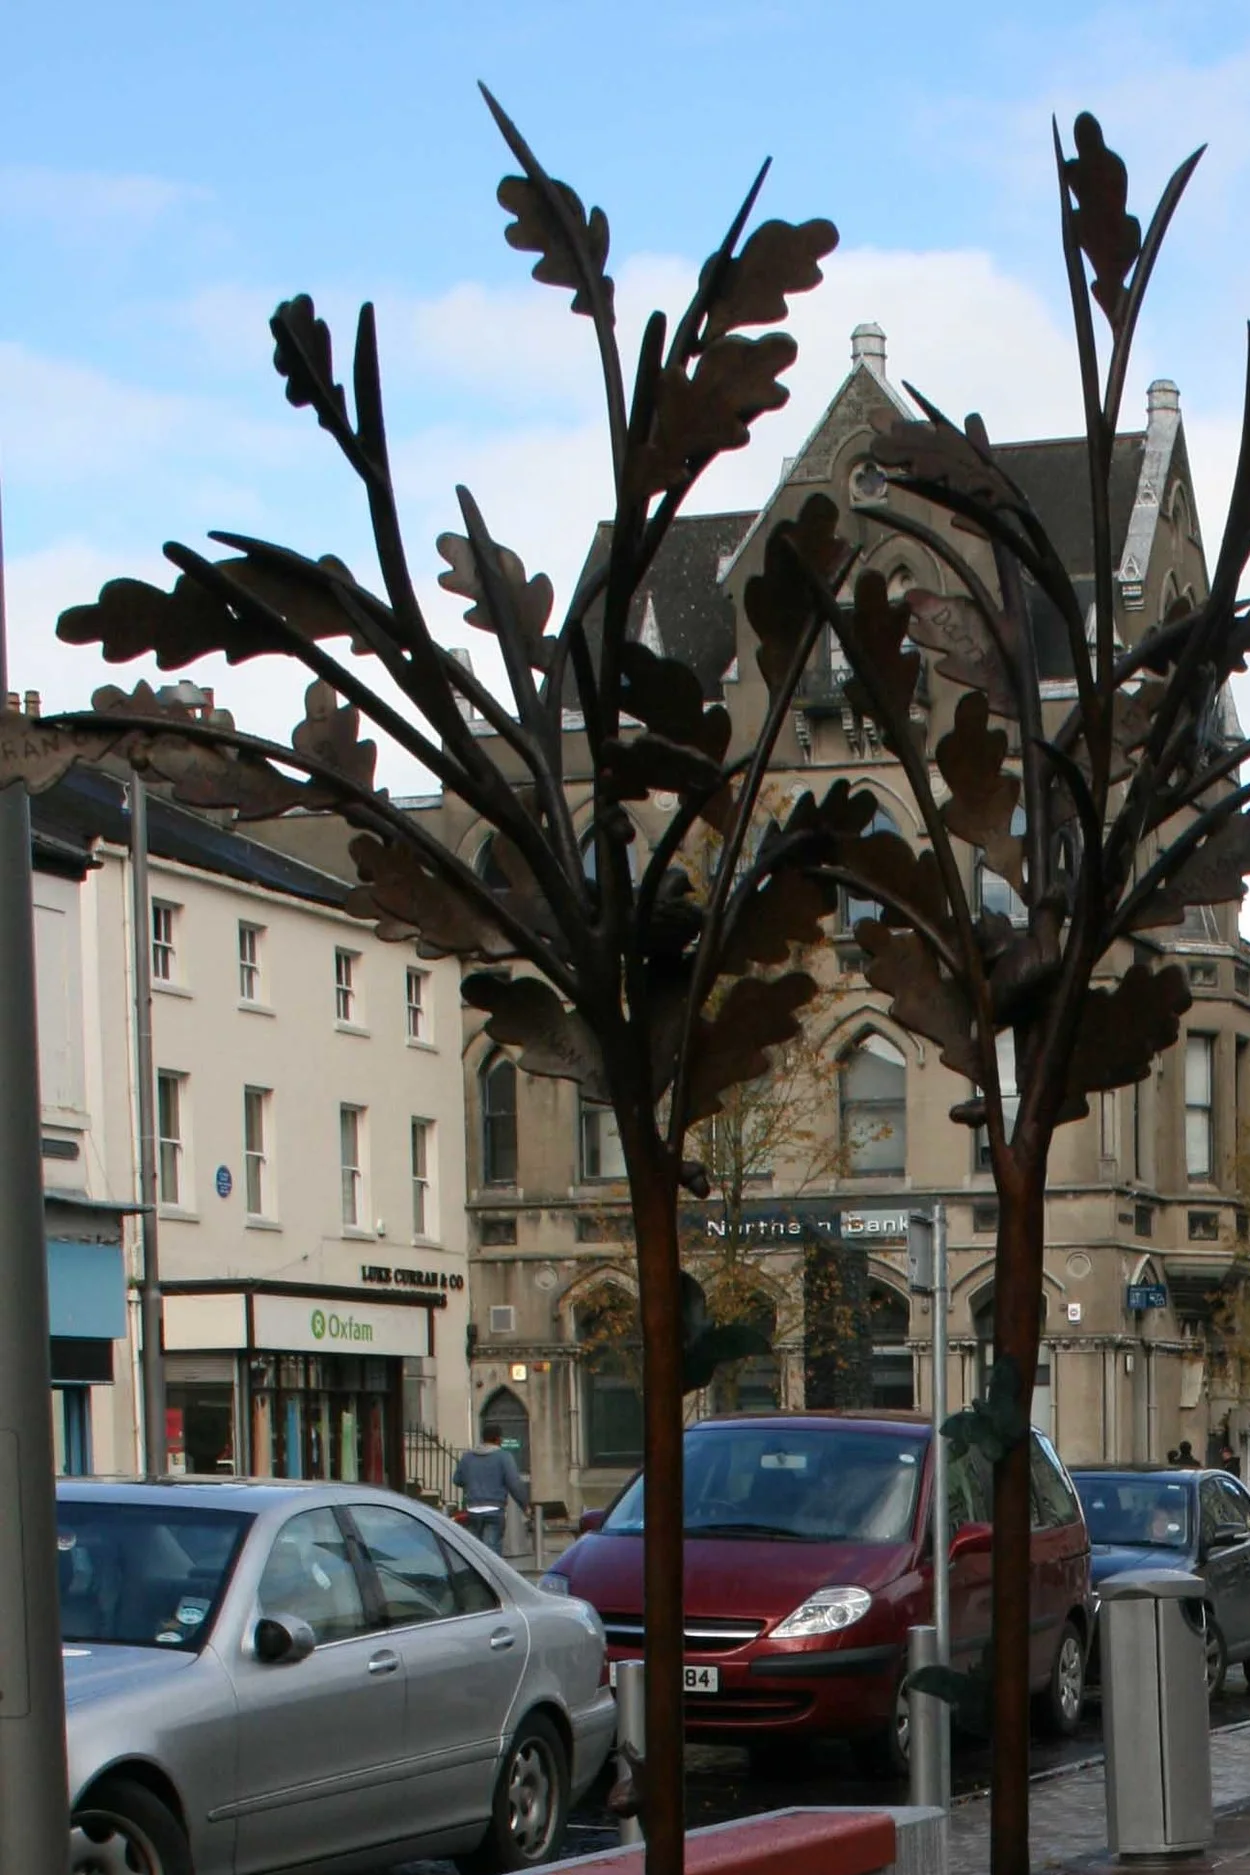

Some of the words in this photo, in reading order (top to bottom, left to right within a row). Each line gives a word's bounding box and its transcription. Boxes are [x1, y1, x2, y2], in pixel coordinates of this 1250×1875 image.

[707, 1218, 831, 1237] Nrthen
[449, 1274, 464, 1291] CO
[328, 1313, 373, 1342] Oxfam
[685, 1669, 710, 1688] 84
